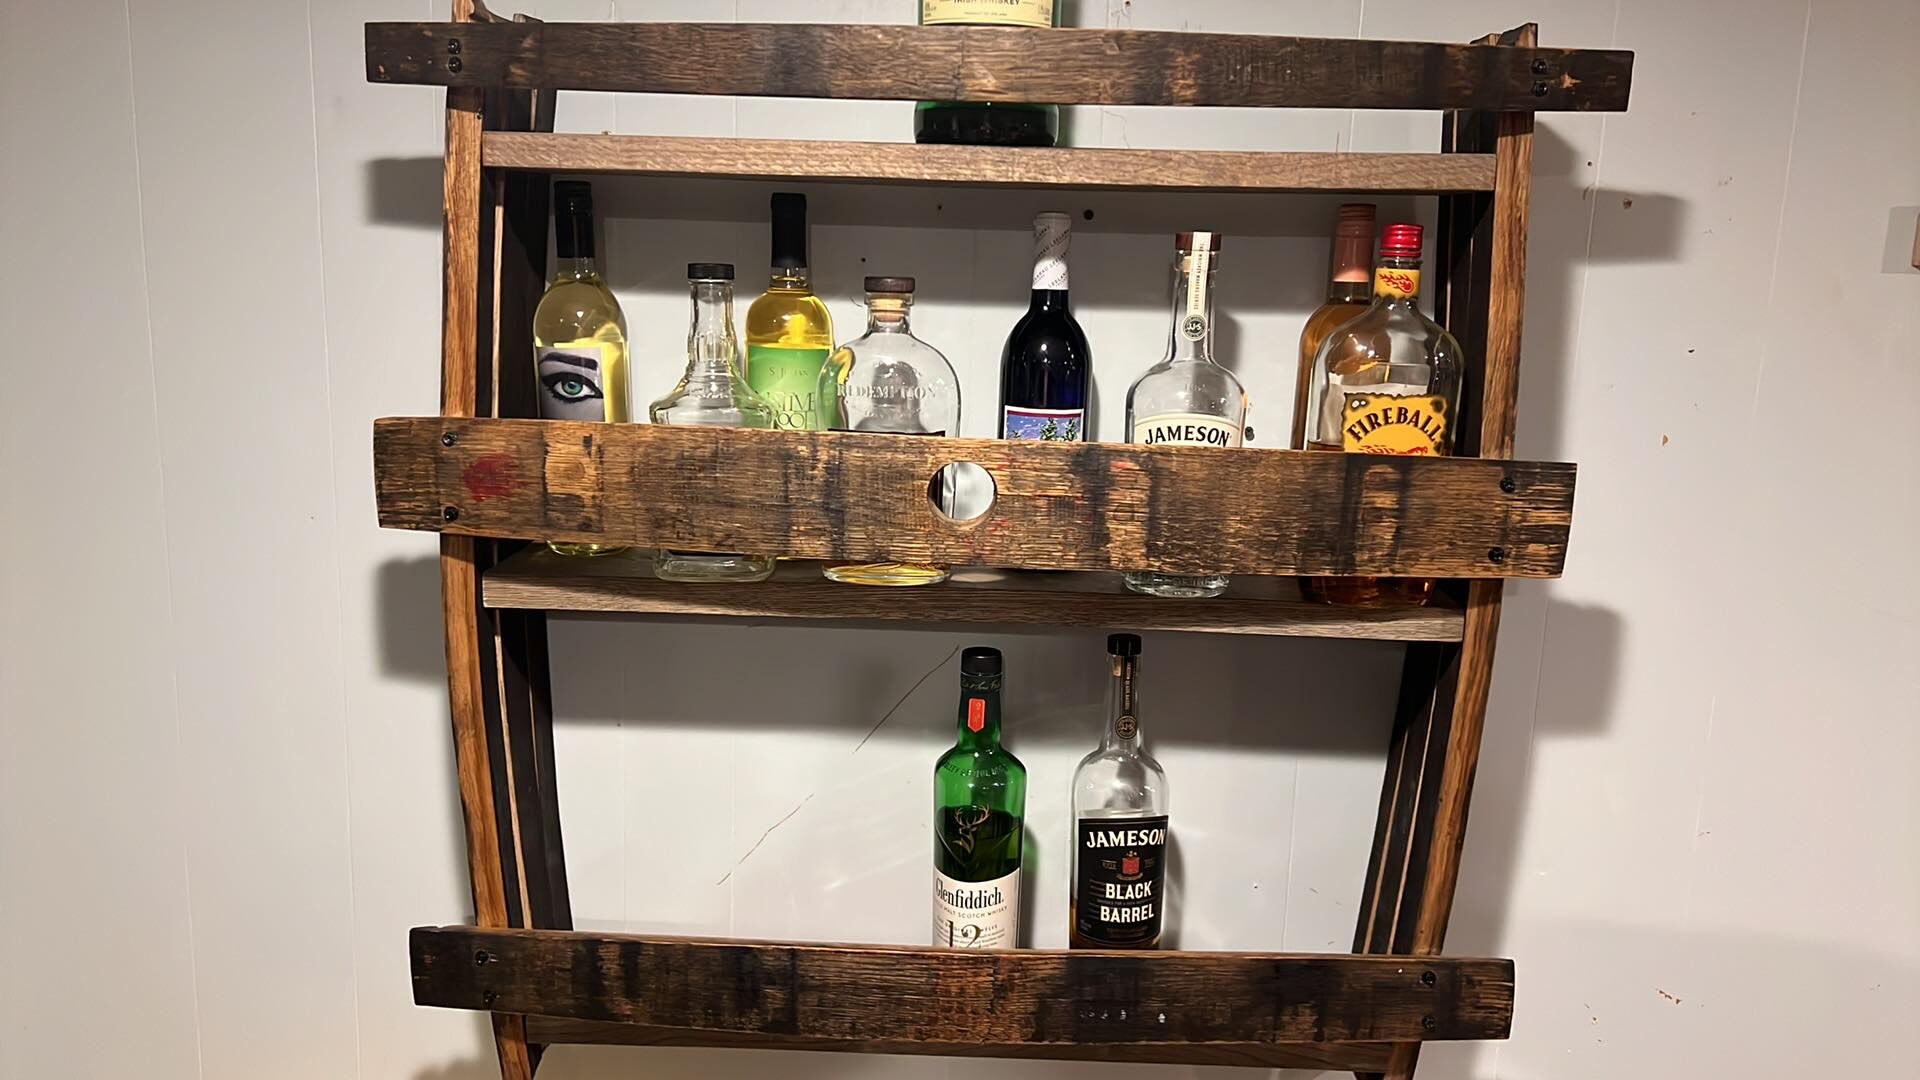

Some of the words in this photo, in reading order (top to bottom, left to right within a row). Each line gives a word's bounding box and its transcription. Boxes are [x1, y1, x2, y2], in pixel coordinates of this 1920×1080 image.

[1346, 406, 1442, 444] FIREBALL
[1144, 425, 1230, 447] JAMESON
[1086, 829, 1166, 848] JAMESON
[1105, 880, 1153, 899] BLACK
[1100, 903, 1154, 923] BARREL
[946, 919, 982, 948] 12
